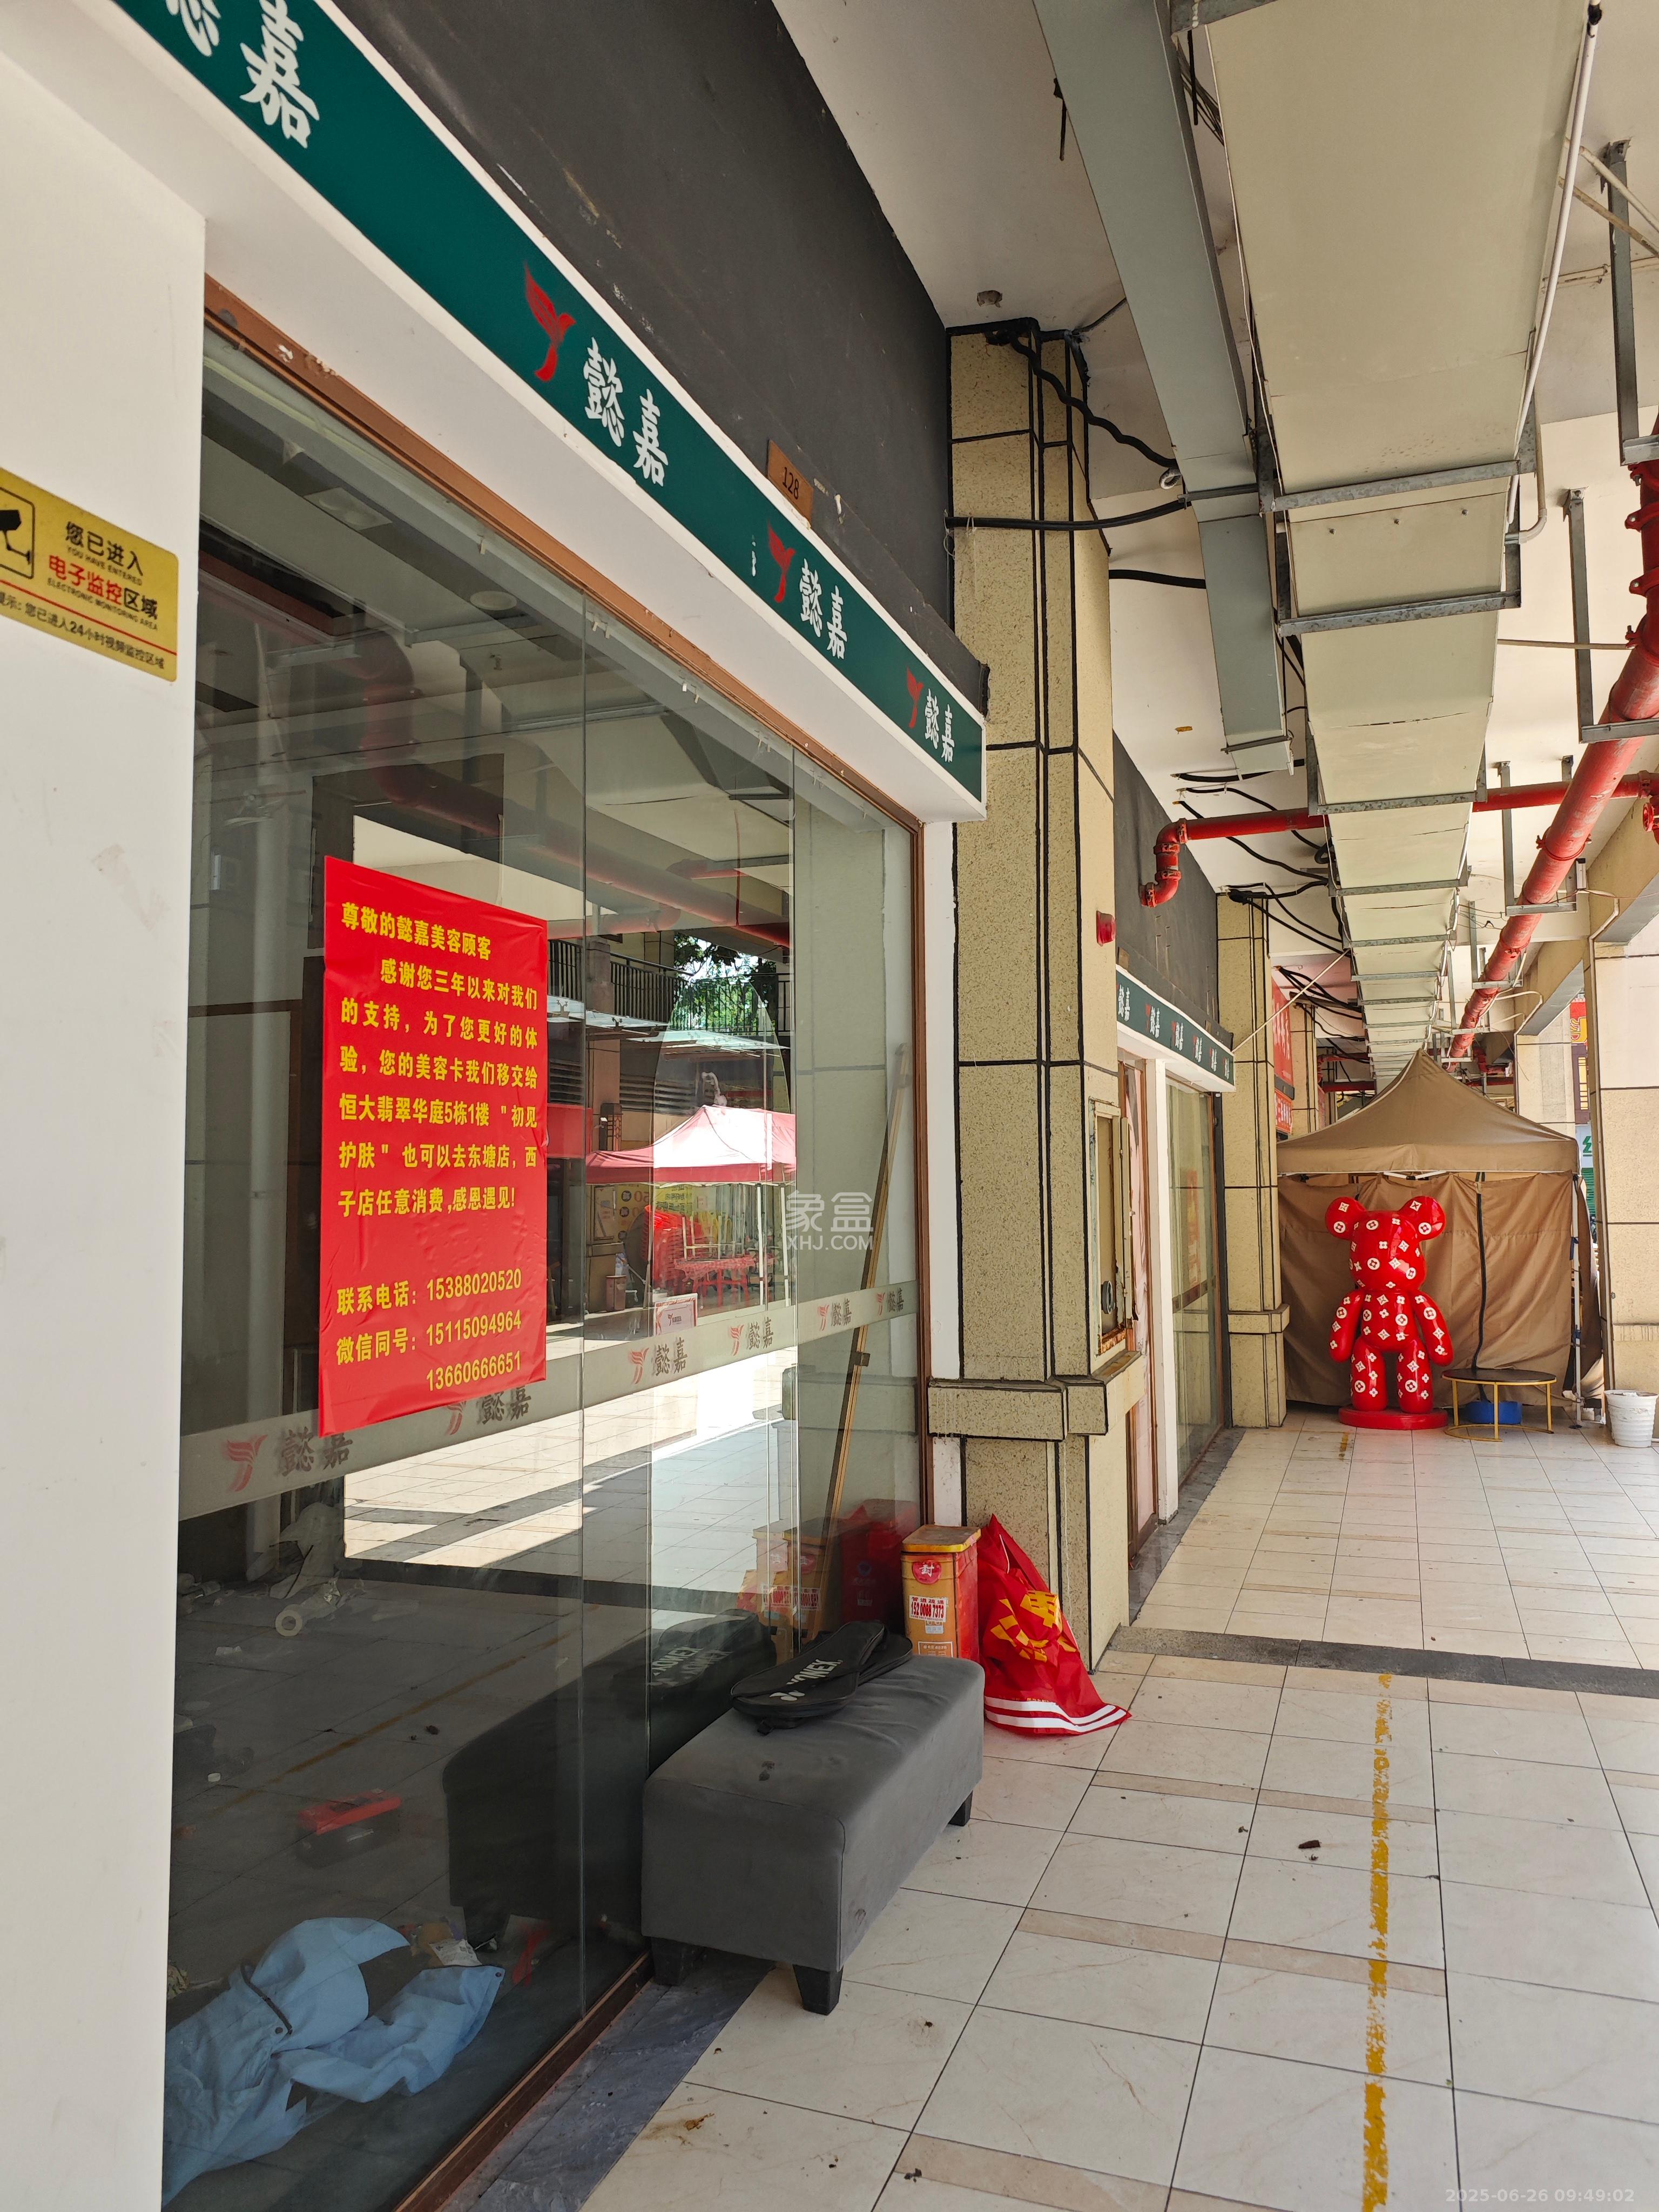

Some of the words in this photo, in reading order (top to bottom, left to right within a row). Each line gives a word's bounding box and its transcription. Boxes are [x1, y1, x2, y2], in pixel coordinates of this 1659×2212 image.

[783, 467, 799, 500] 128
[65, 521, 144, 576] 您已进入
[107, 565, 142, 586] ENTERED
[584, 337, 668, 487] 懿嘉
[799, 558, 847, 659] 懿嘉
[925, 688, 955, 763] 懿嘉
[49, 555, 158, 620] 电子监控区域
[341, 901, 491, 961] 尊敬的懿嘉美容顾客
[380, 957, 537, 1011] 感谢您三年以来对我们
[427, 1350, 522, 1392] 13660666651
[654, 1337, 688, 1377] 懿嘉
